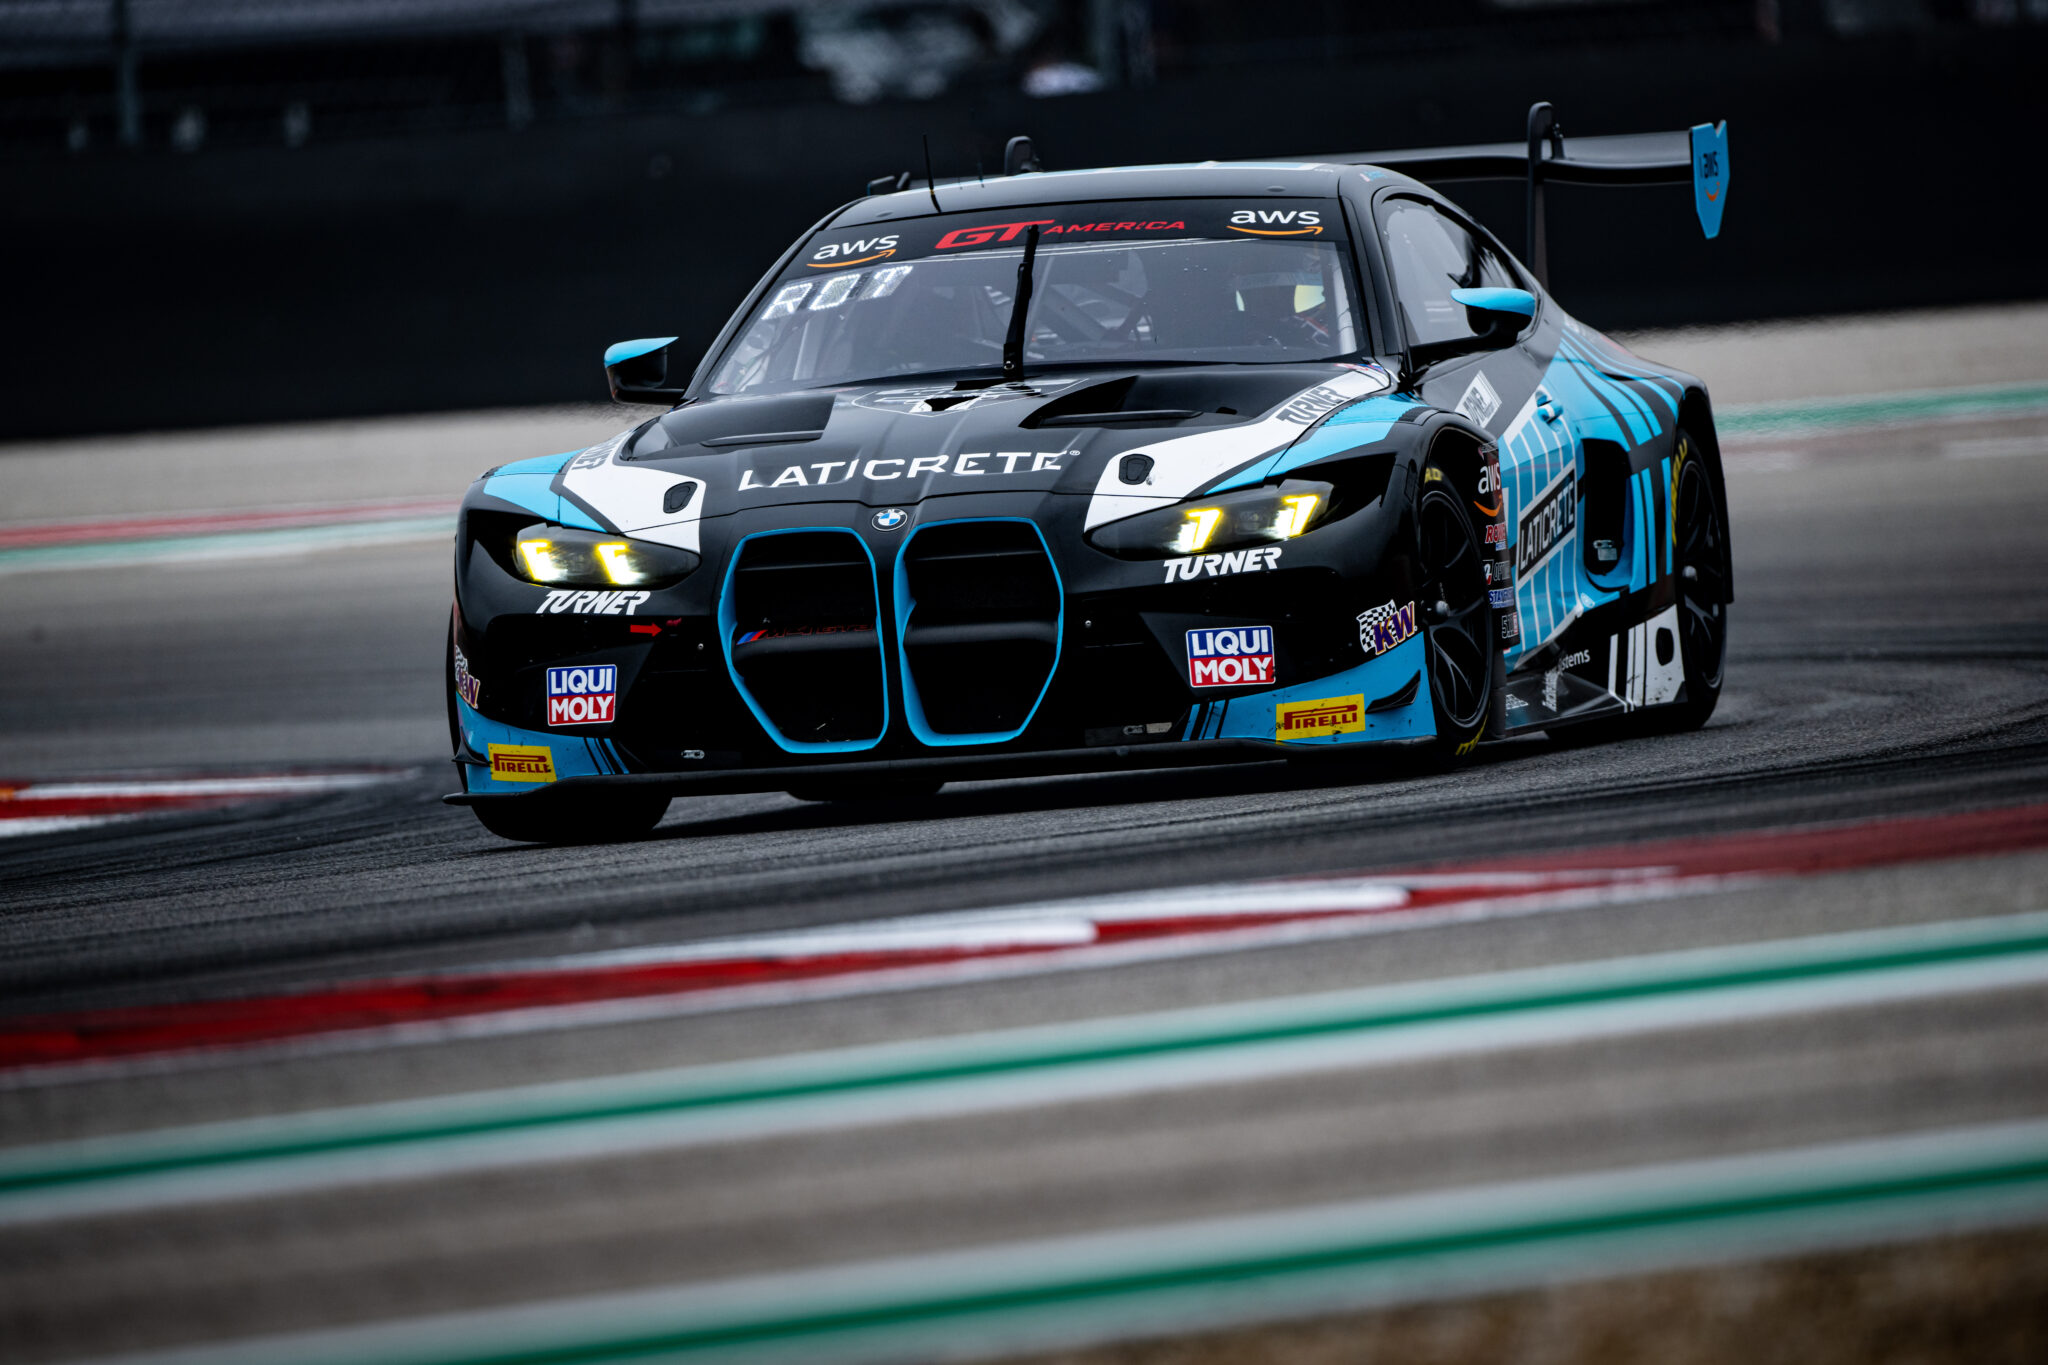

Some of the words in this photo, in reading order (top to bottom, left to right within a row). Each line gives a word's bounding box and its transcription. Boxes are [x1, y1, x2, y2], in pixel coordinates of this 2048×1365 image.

[1230, 209, 1321, 225] aws
[813, 234, 900, 260] aws
[935, 219, 1054, 249] GT
[1042, 220, 1186, 235] AMERICA
[1275, 386, 1351, 426] TURNER
[1478, 462, 1501, 494] aws
[1520, 482, 1576, 568] LATICRETE
[1163, 547, 1282, 584] TURNER
[535, 590, 651, 616] TURNER
[1373, 601, 1415, 655] KW
[1191, 629, 1269, 656] LIQUI
[550, 668, 613, 694] LIQUI
[1193, 657, 1272, 684] MOLY
[551, 695, 614, 722] MOLY
[1284, 704, 1358, 730] PIRELLI
[493, 753, 550, 773] PIRELLI
